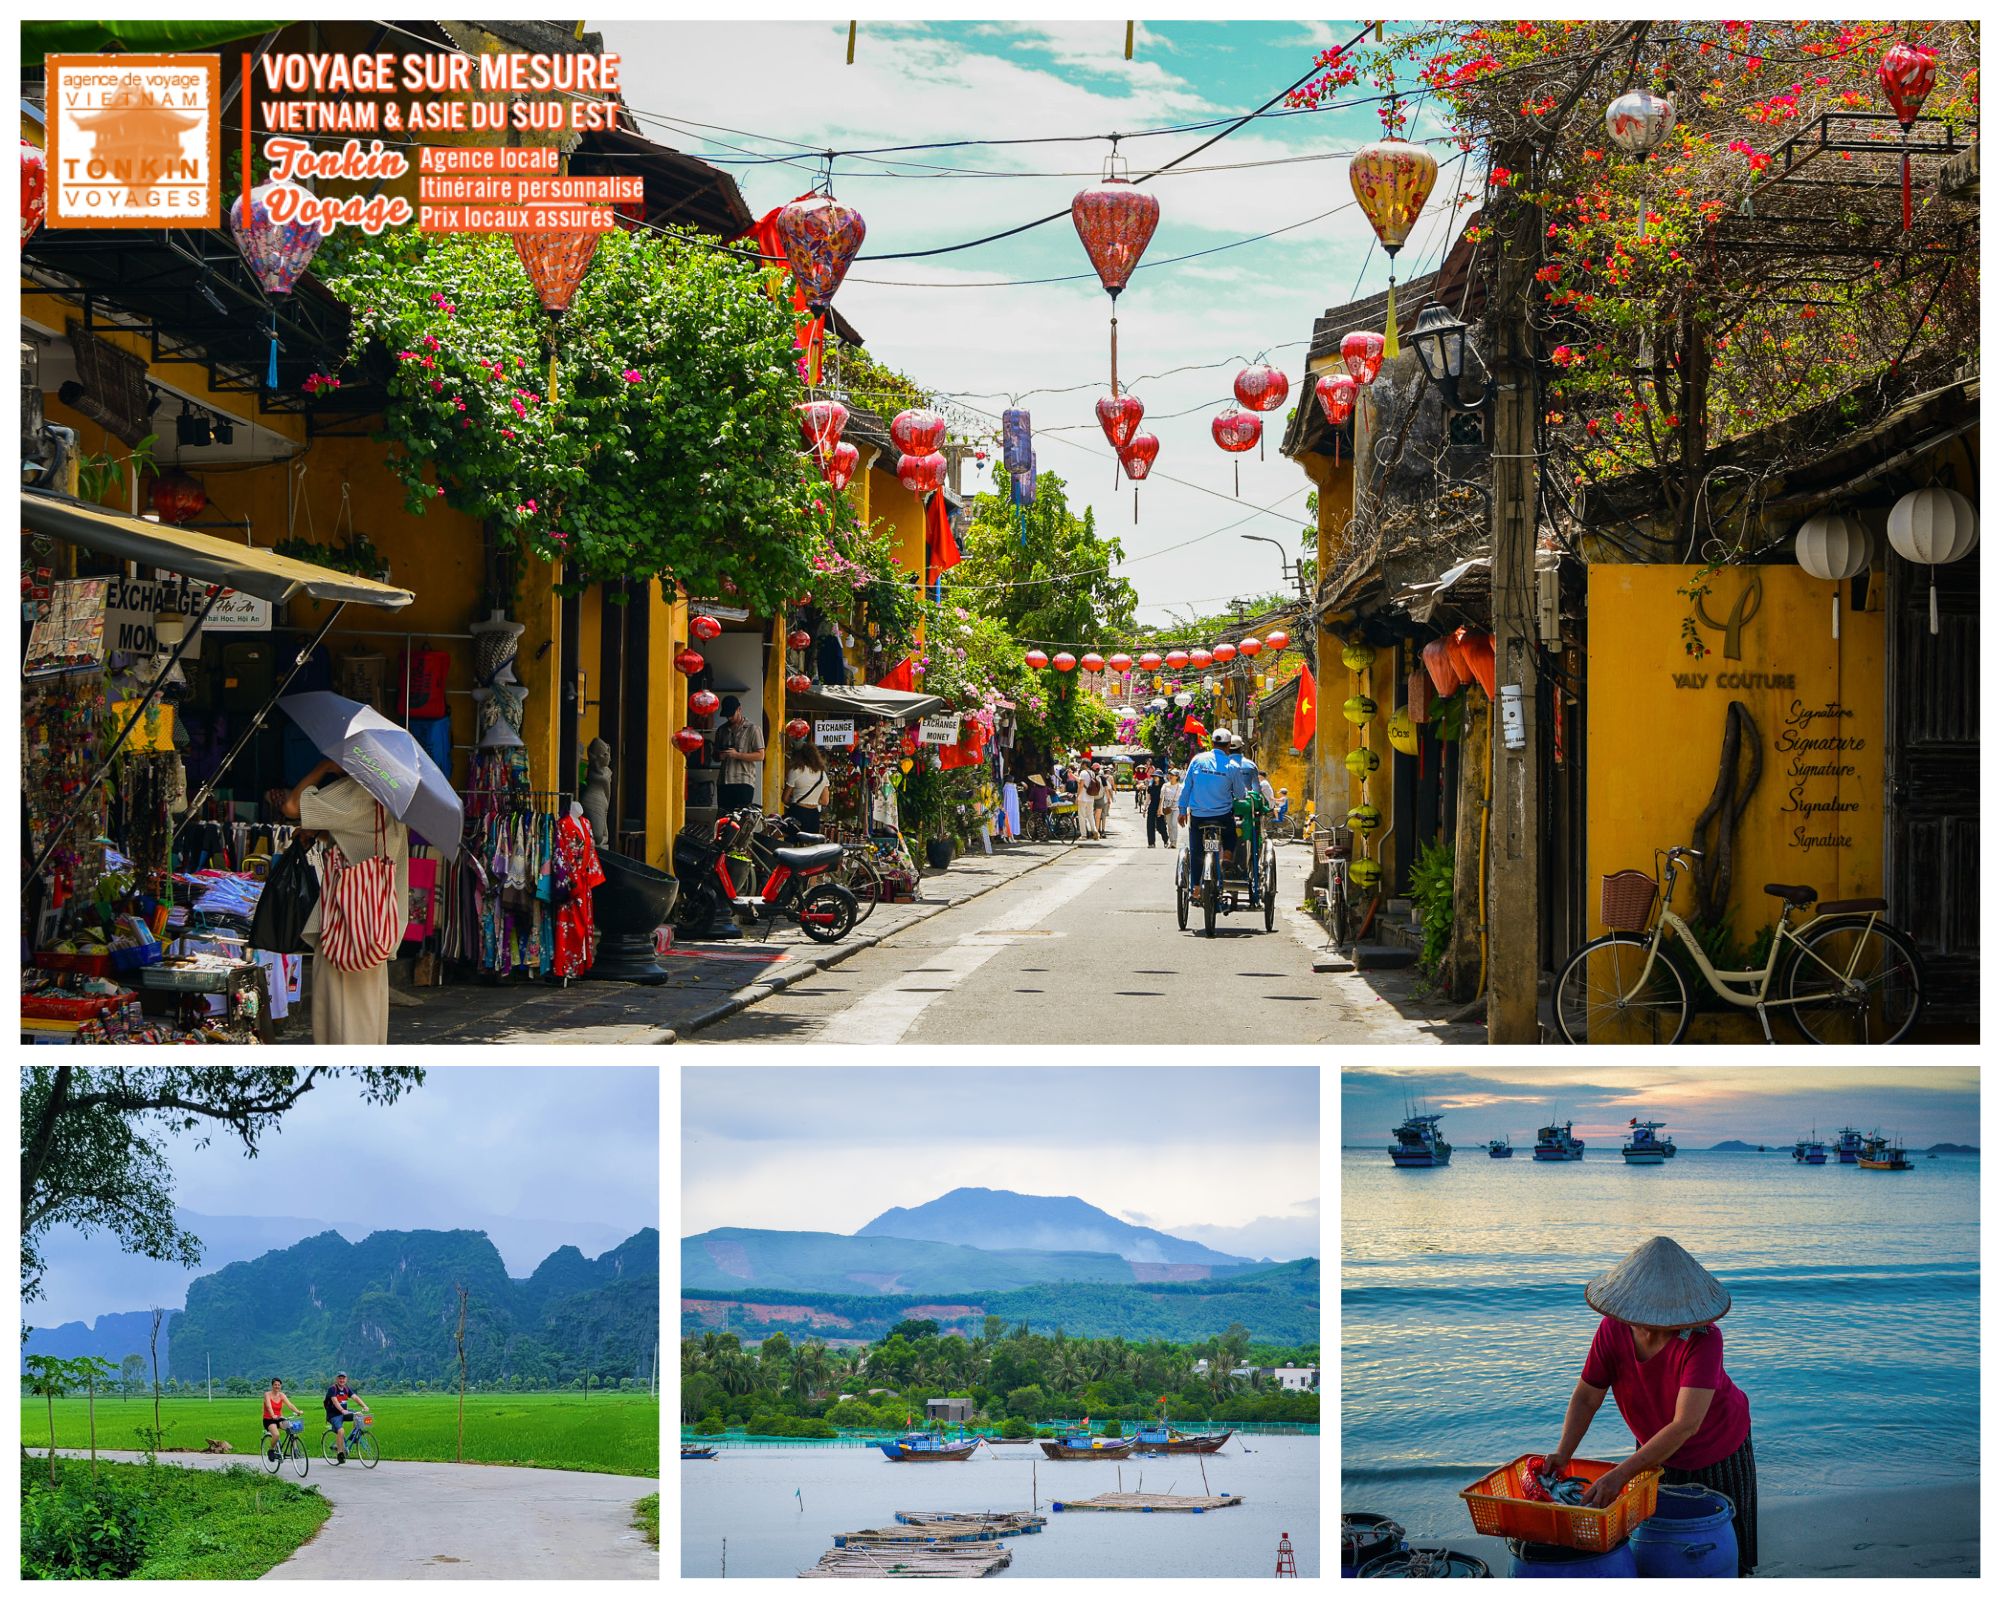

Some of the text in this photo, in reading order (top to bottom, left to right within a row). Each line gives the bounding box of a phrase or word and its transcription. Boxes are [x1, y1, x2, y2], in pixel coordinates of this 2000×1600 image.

[106, 582, 202, 617] EXCHAGE
[1671, 672, 1797, 690] YALY COUTURE
[816, 722, 853, 732] EXCHANGE
[922, 718, 958, 729] EXCHANGE
[1784, 699, 1854, 729] Signature
[822, 734, 847, 743] MONEY
[926, 732, 951, 741] MONEY
[1774, 729, 1866, 757] Signature
[1787, 757, 1856, 786] Signature
[1780, 786, 1860, 820] Signature
[1788, 826, 1853, 853] Signature
